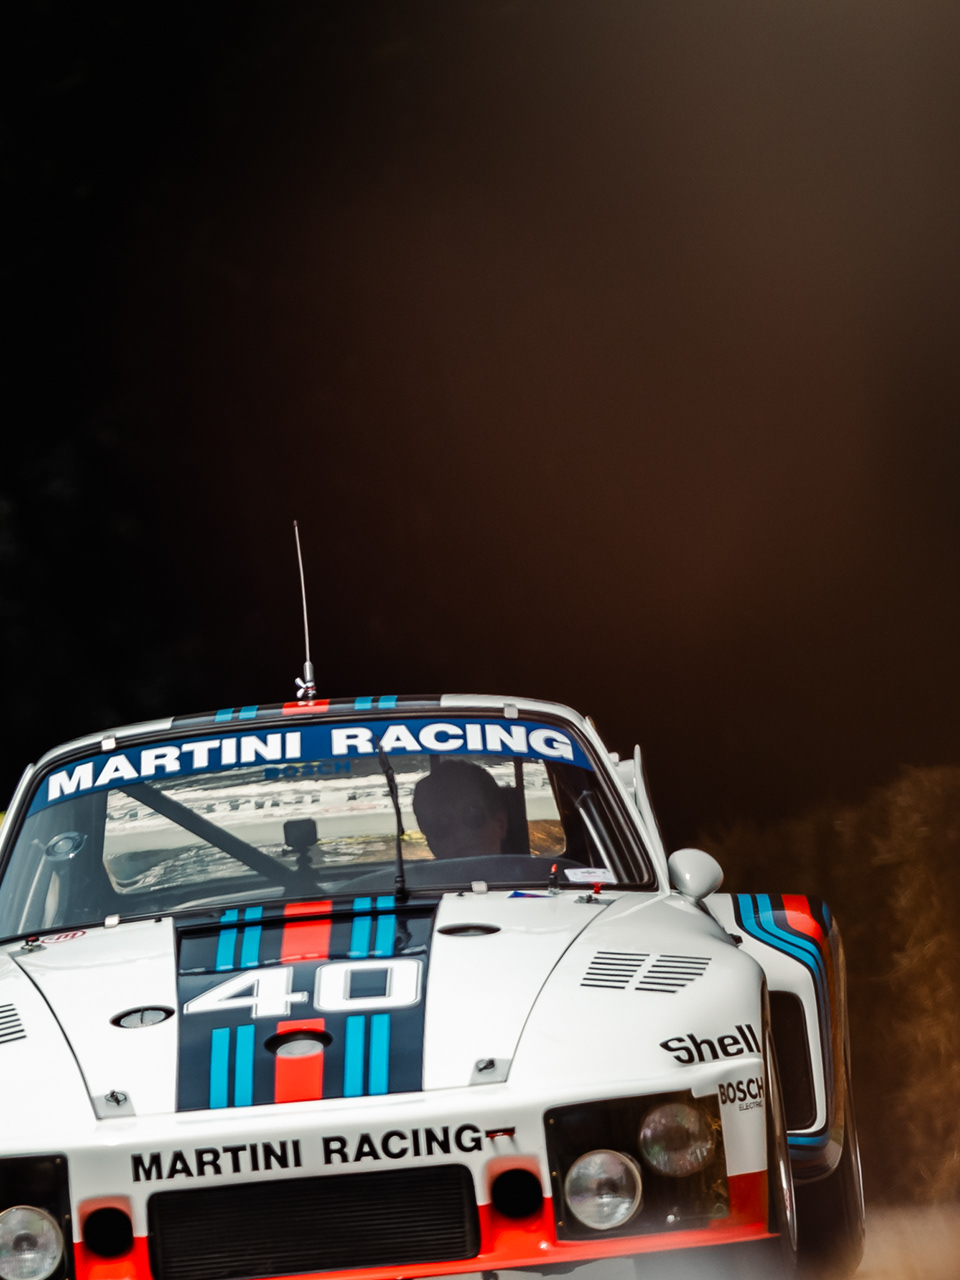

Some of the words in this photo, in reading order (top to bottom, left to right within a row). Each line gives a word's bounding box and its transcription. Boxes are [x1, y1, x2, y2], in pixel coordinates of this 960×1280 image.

[47, 731, 302, 802] MARTINI
[331, 722, 575, 761] RACING
[183, 958, 424, 1019] 40
[659, 1023, 762, 1064] Shell
[718, 1076, 765, 1105] BOSCH
[131, 1138, 302, 1183] MARTINI
[322, 1123, 484, 1165] RACING
